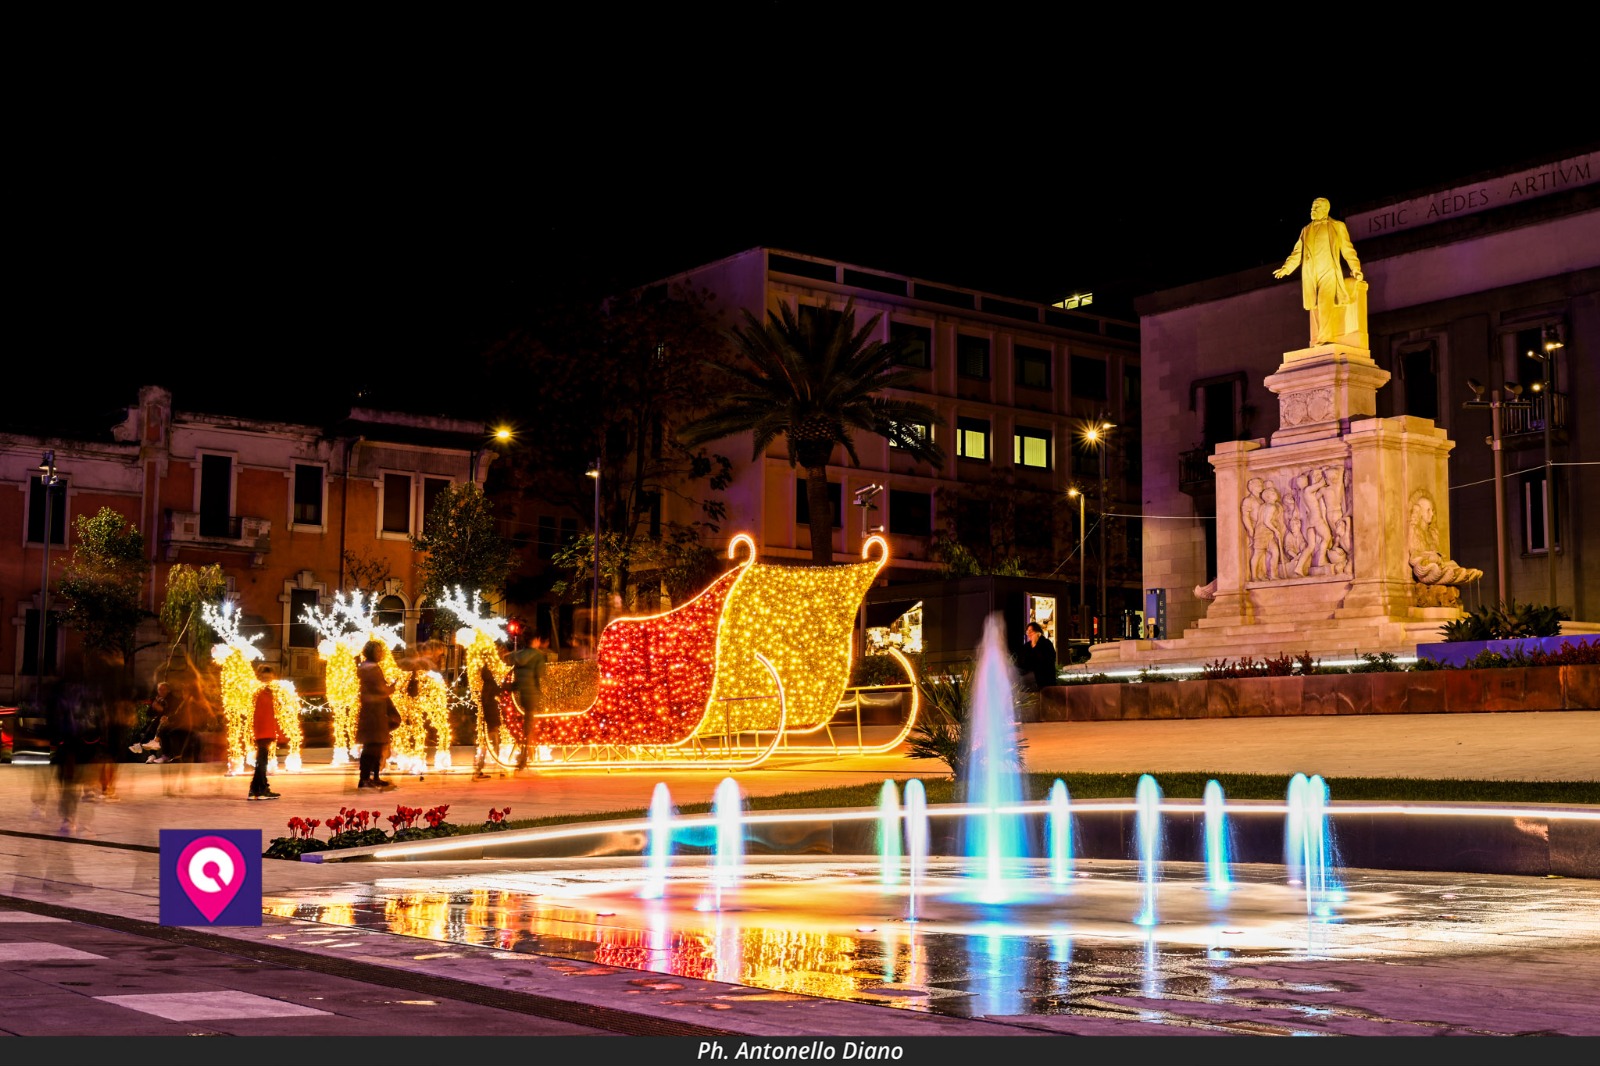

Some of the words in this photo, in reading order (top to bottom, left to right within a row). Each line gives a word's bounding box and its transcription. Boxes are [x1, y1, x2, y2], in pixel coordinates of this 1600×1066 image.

[1368, 209, 1408, 233] ISTIC
[1427, 189, 1489, 218] AEDES
[1509, 163, 1591, 198] ARTIVM
